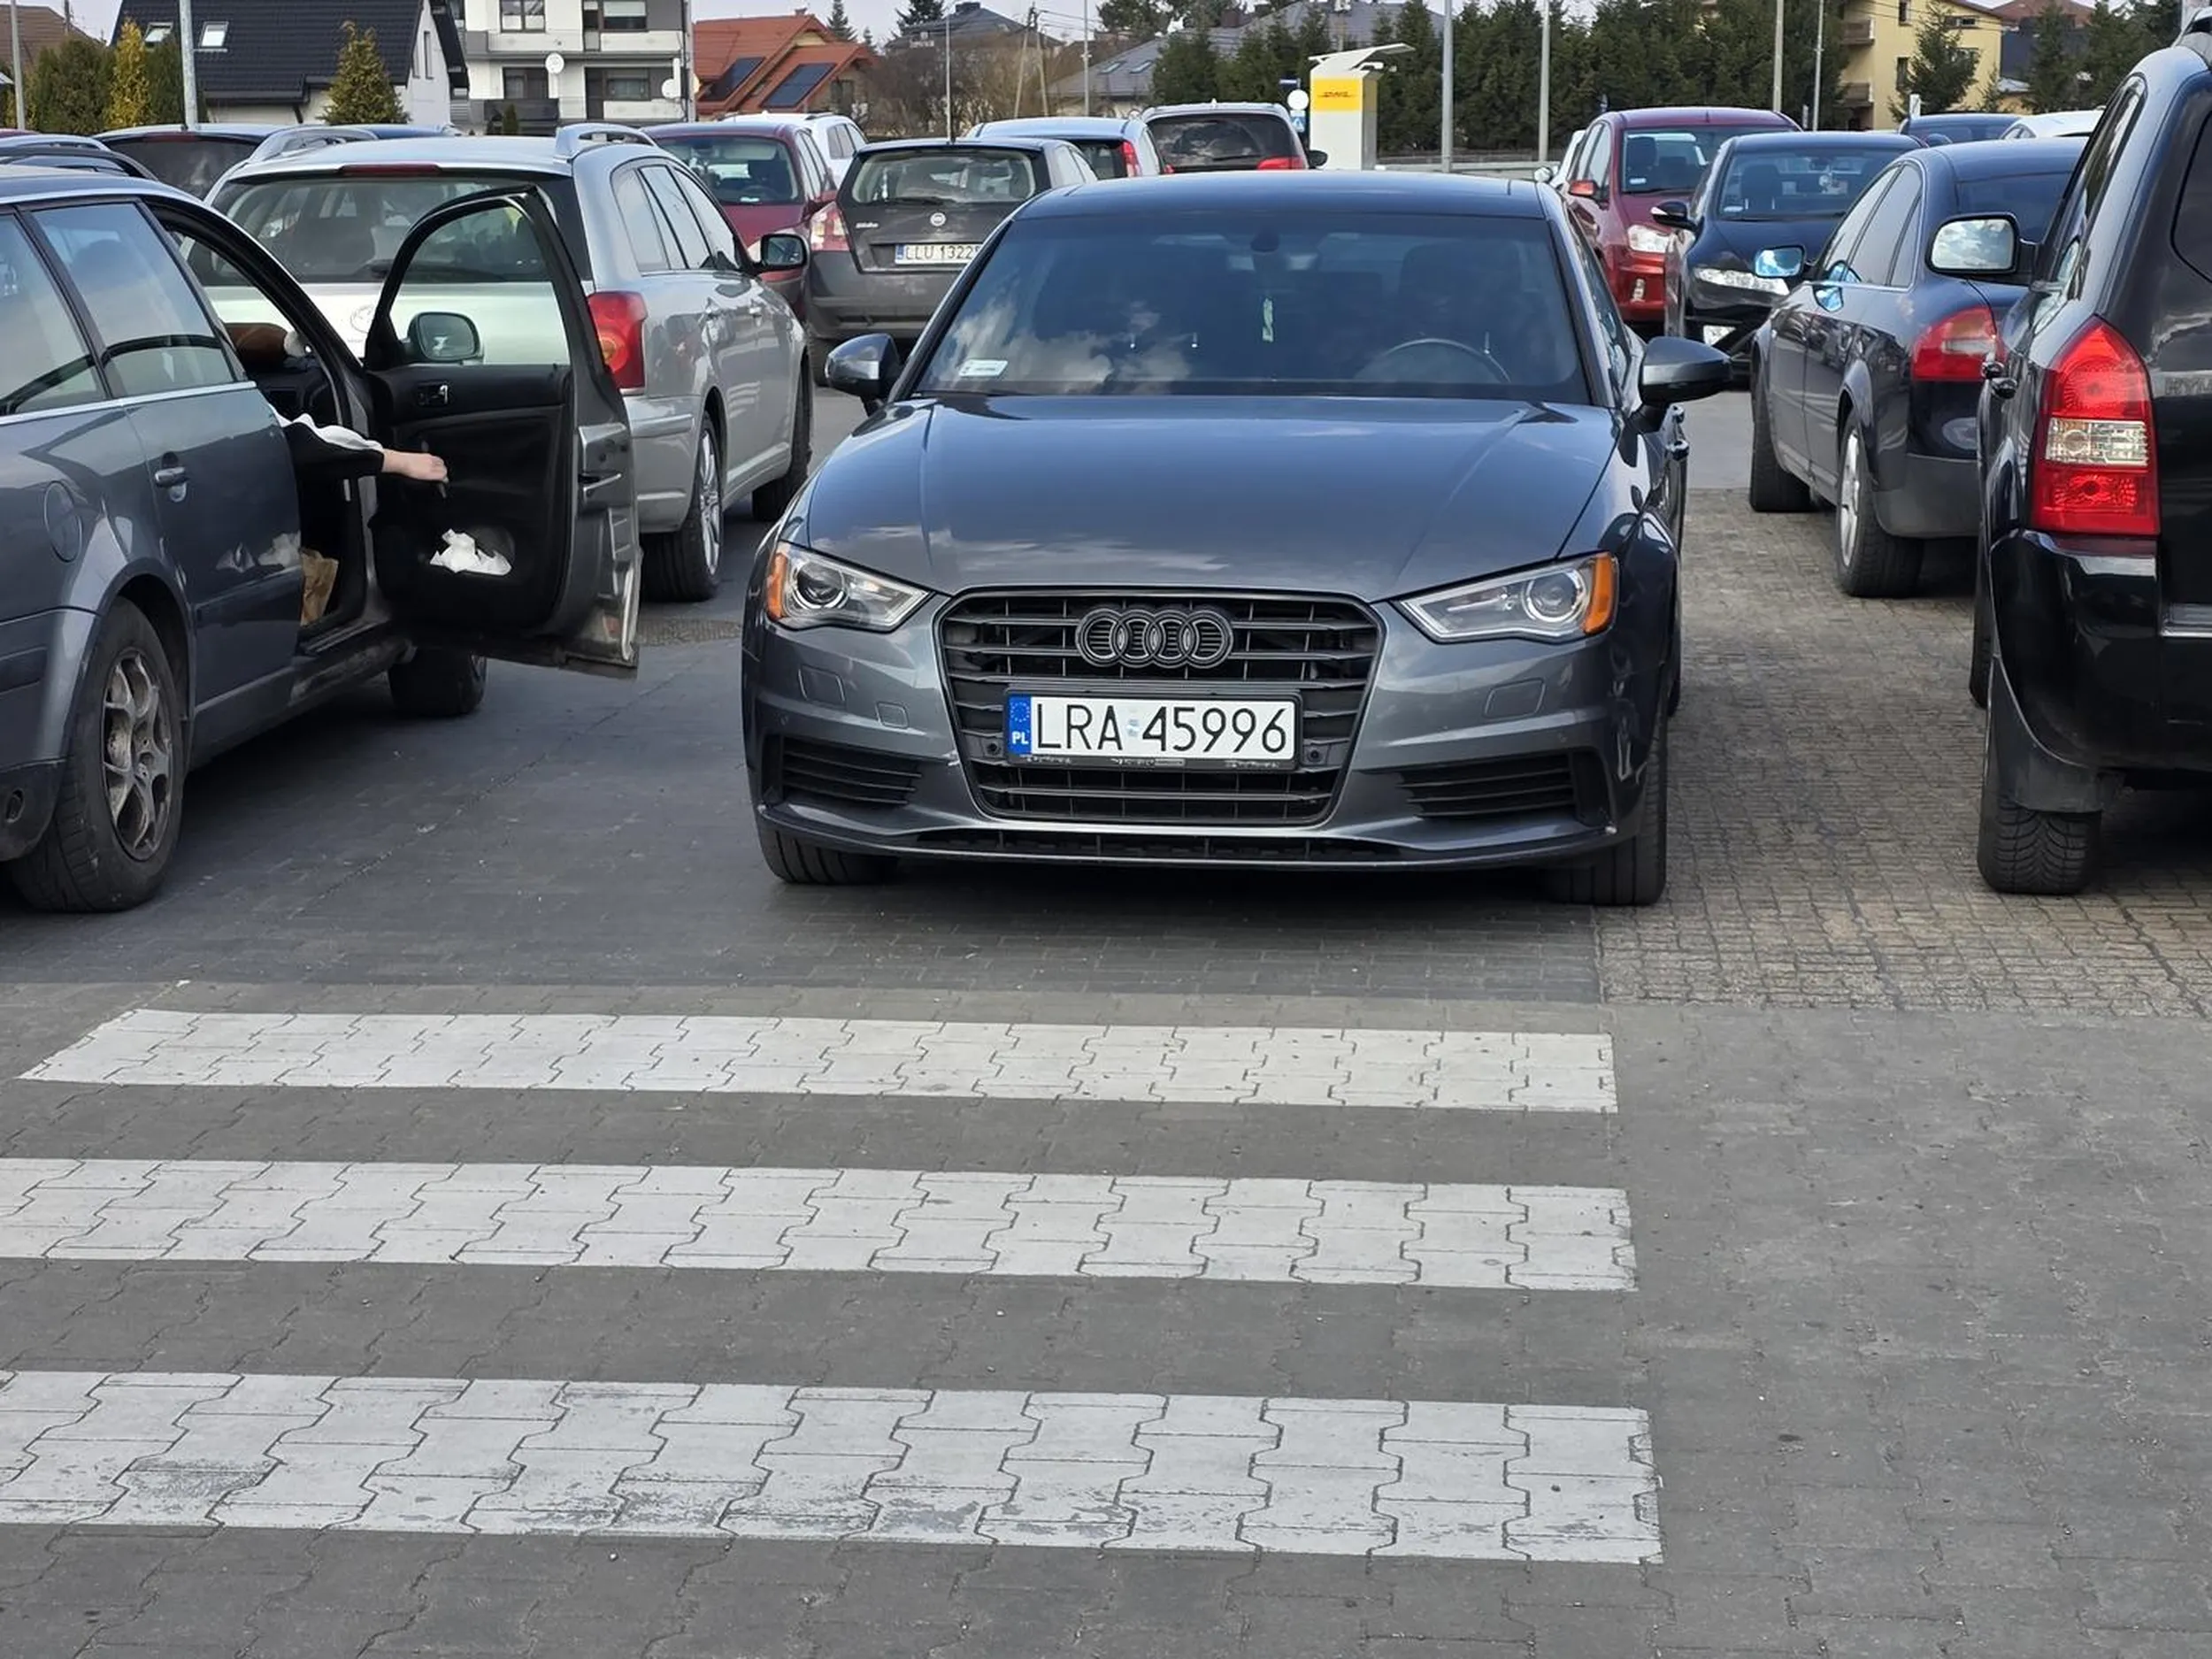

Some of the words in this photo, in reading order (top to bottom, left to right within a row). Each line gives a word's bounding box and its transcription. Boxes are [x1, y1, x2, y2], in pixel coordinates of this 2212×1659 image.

[906, 246, 933, 260] LLU
[1037, 703, 1123, 750] LRA
[1142, 706, 1286, 753] 45996
[1011, 731, 1029, 744] PL
